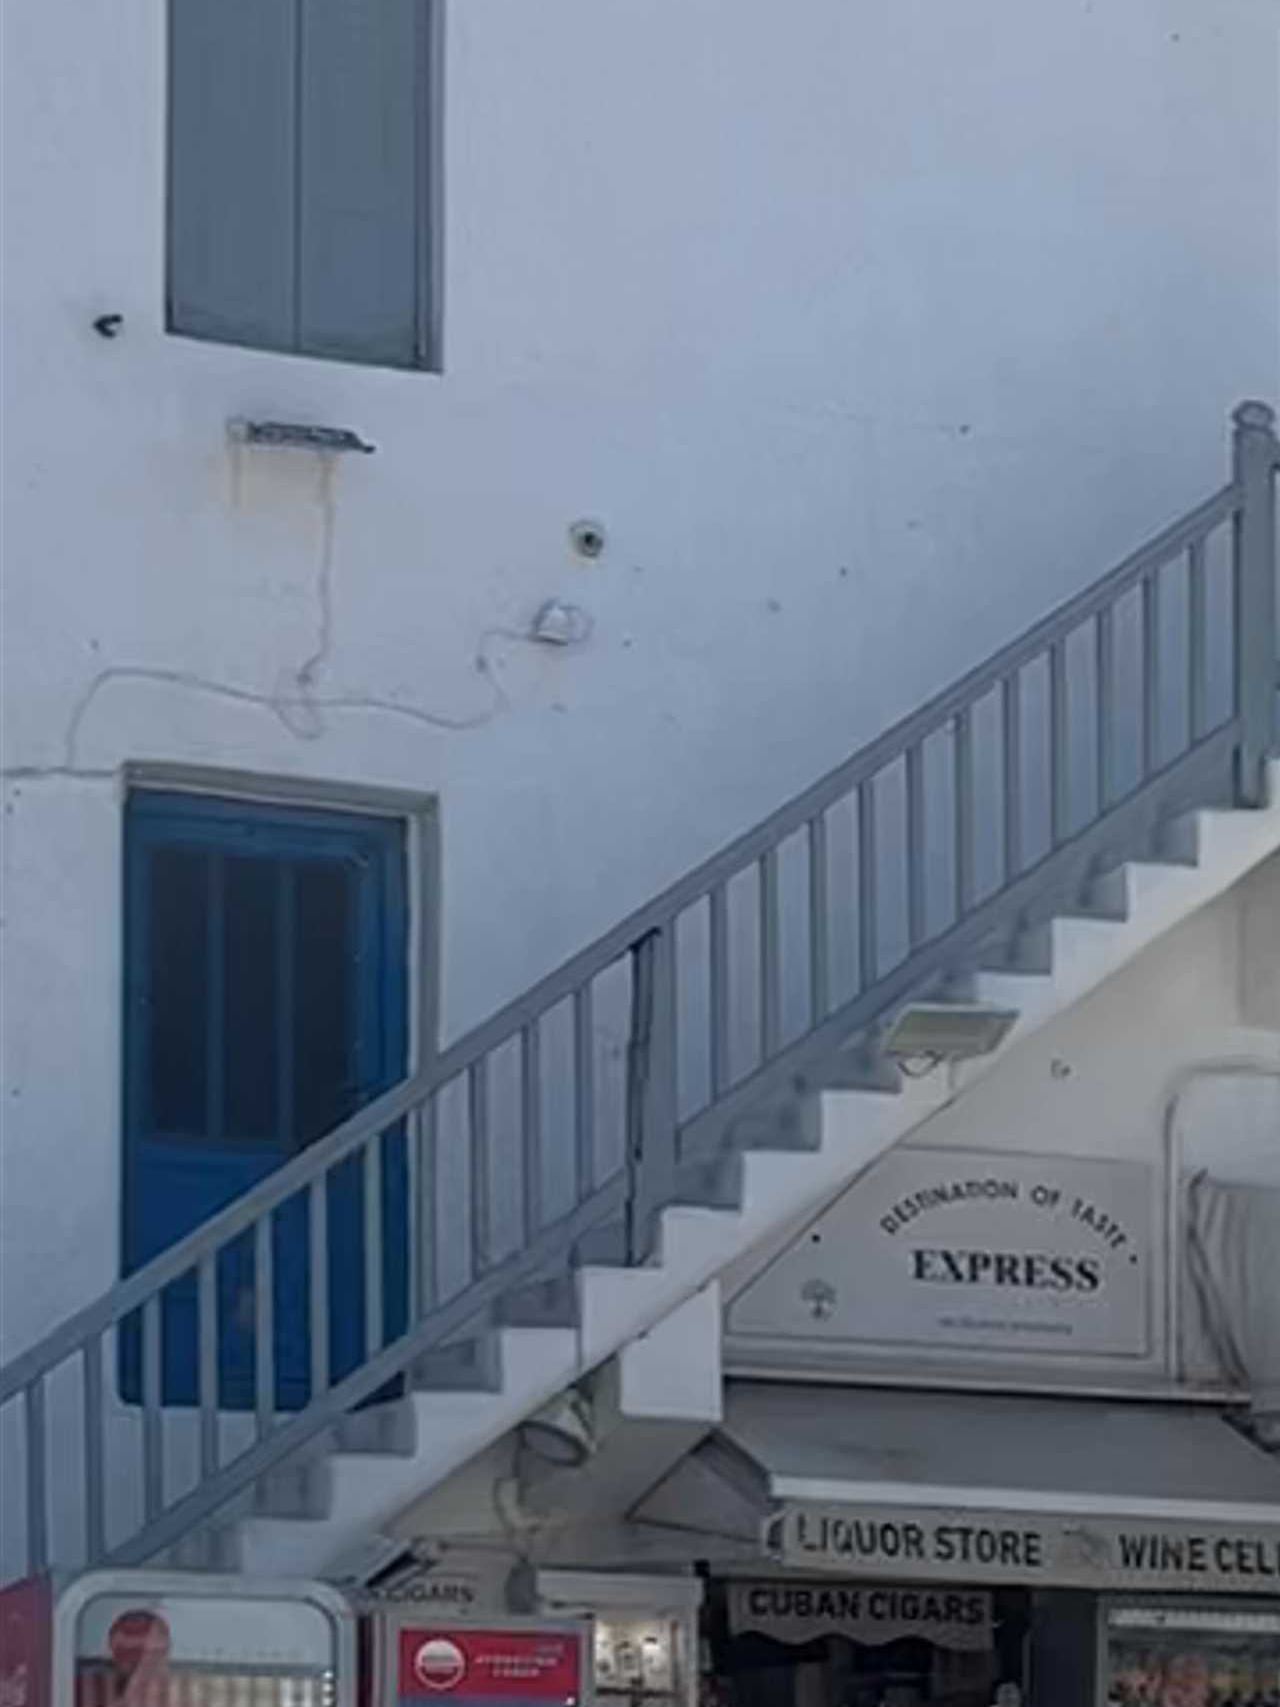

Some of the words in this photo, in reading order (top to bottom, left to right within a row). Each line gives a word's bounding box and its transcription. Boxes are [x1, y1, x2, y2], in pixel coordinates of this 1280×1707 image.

[880, 1178, 1018, 1236] DESTINATION
[1030, 1184, 1062, 1207] OF
[1071, 1197, 1128, 1249] TASTE
[911, 1248, 1100, 1292] EXPRESS
[797, 1513, 925, 1559] LIQUOR
[934, 1525, 1043, 1568] STORE
[1118, 1533, 1207, 1573] WINE
[748, 1590, 860, 1620] CUBAN
[867, 1593, 985, 1625] CIGARS
